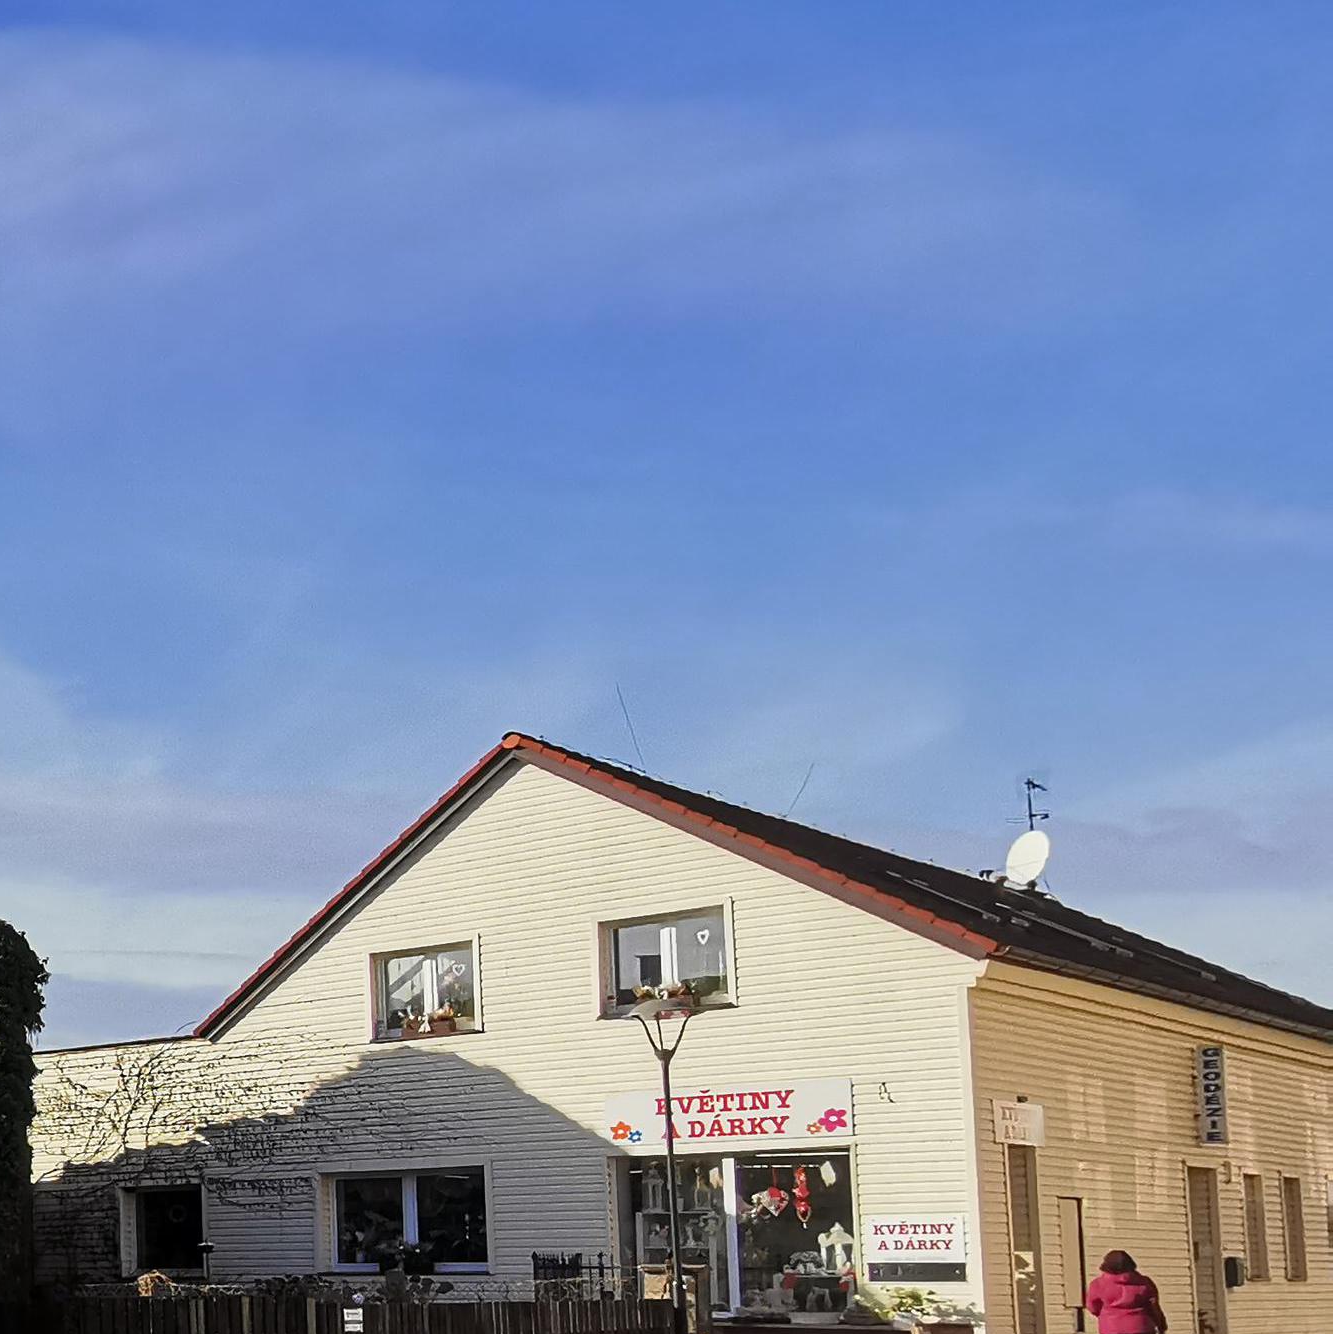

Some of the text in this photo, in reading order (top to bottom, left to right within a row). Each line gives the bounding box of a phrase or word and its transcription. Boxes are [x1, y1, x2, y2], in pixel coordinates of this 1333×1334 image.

[688, 1115, 790, 1139] DÁRKY
[873, 1221, 955, 1236] KVĚTINY
[877, 1236, 953, 1251] A DÁRKY
